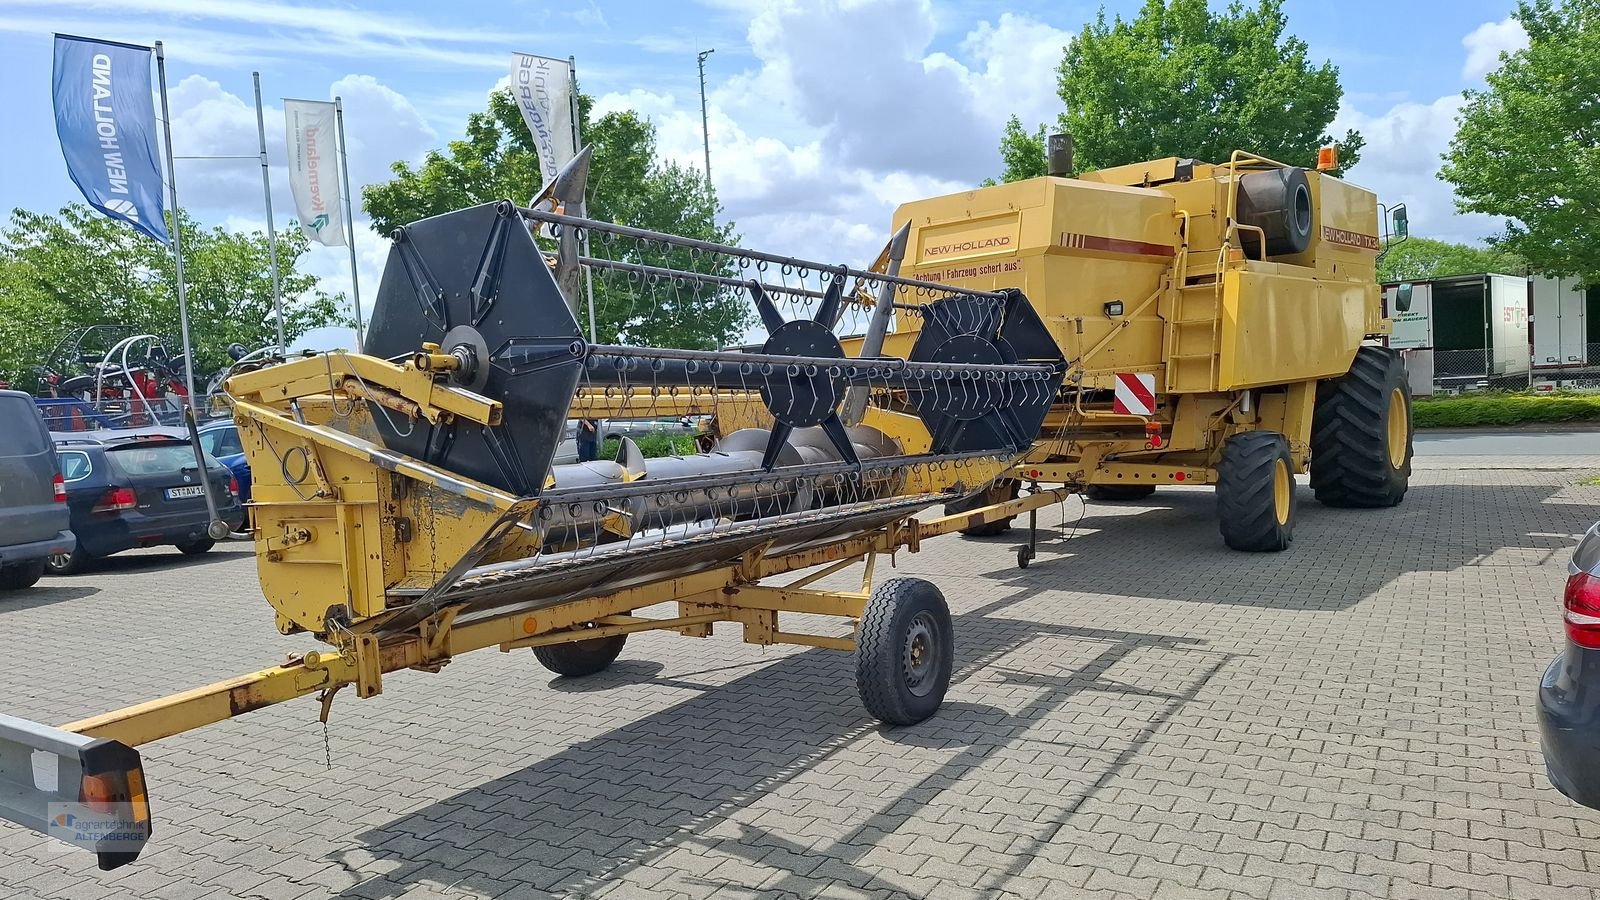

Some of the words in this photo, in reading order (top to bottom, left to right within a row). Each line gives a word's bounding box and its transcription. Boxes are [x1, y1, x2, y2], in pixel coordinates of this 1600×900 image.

[1335, 230, 1361, 245] HOLLAND
[925, 246, 951, 257] NEW
[953, 236, 1010, 252] HOLLAND
[946, 267, 977, 279] Fahrzeug
[979, 262, 1001, 275] schert
